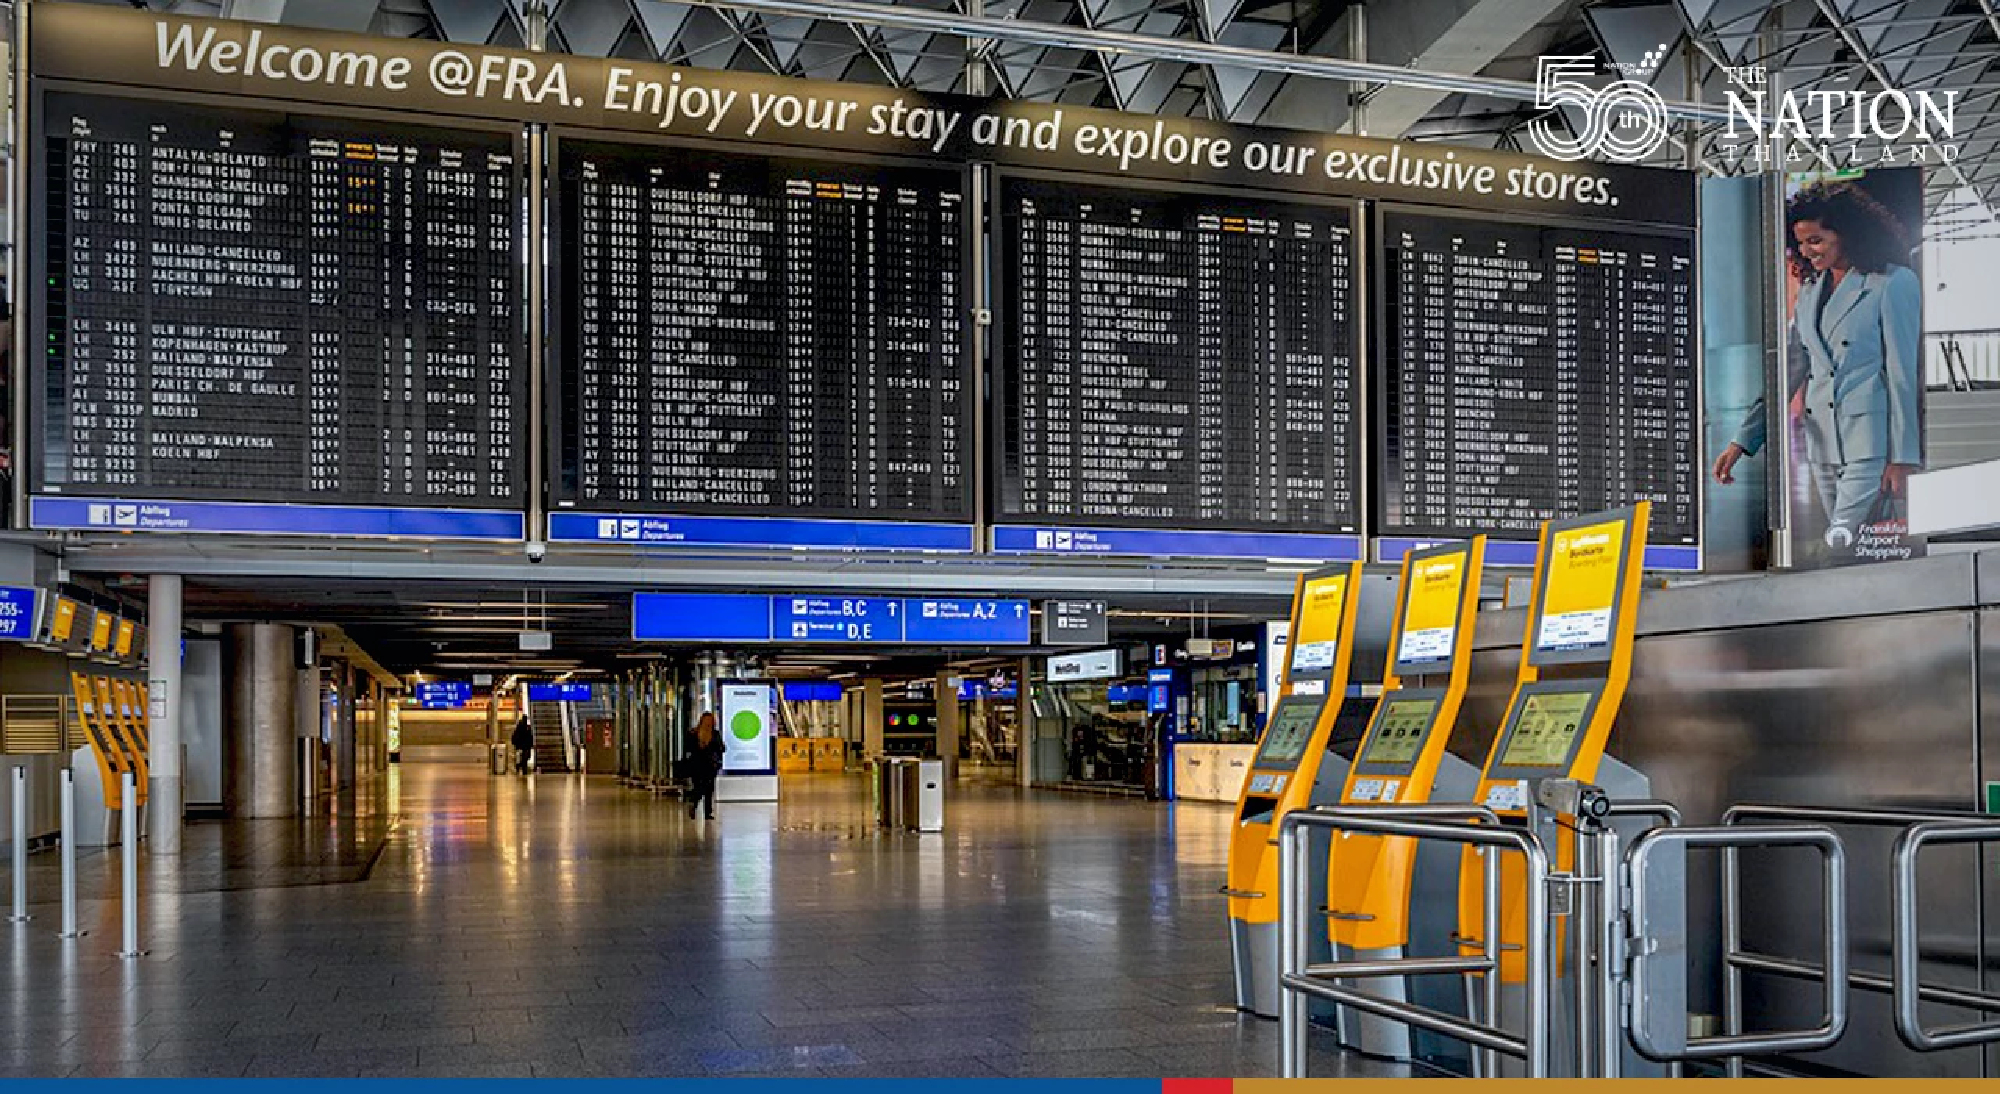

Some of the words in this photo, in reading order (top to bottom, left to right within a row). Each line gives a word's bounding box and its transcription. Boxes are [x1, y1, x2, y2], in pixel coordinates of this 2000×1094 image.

[155, 22, 411, 89] Welcome
[428, 52, 584, 108] @FRA.
[605, 67, 739, 134] Enjoy
[748, 92, 856, 134] your
[867, 101, 961, 152] stay
[972, 104, 1061, 151] and
[1074, 113, 1230, 168] explore
[1245, 144, 1314, 177] our
[1323, 146, 1496, 195] exclusive
[1505, 168, 1619, 207] stores.
[72, 154, 88, 166] AZ
[73, 168, 88, 179] CZ
[74, 182, 89, 192] LH
[74, 208, 89, 220] TU
[74, 237, 89, 247] AZ
[74, 251, 89, 261] LH
[74, 265, 89, 275] LH
[74, 319, 89, 330] LH
[74, 333, 89, 344] LH
[74, 348, 89, 358] LH
[74, 360, 88, 371] LH
[152, 378, 189, 389] PARIS
[74, 429, 89, 440] LH
[74, 443, 89, 453] LH
[1857, 534, 1900, 547] Airport
[1855, 546, 1911, 560] Shopping
[842, 600, 867, 617] B,C
[972, 603, 997, 620] A,Z
[848, 624, 872, 640] D,E
